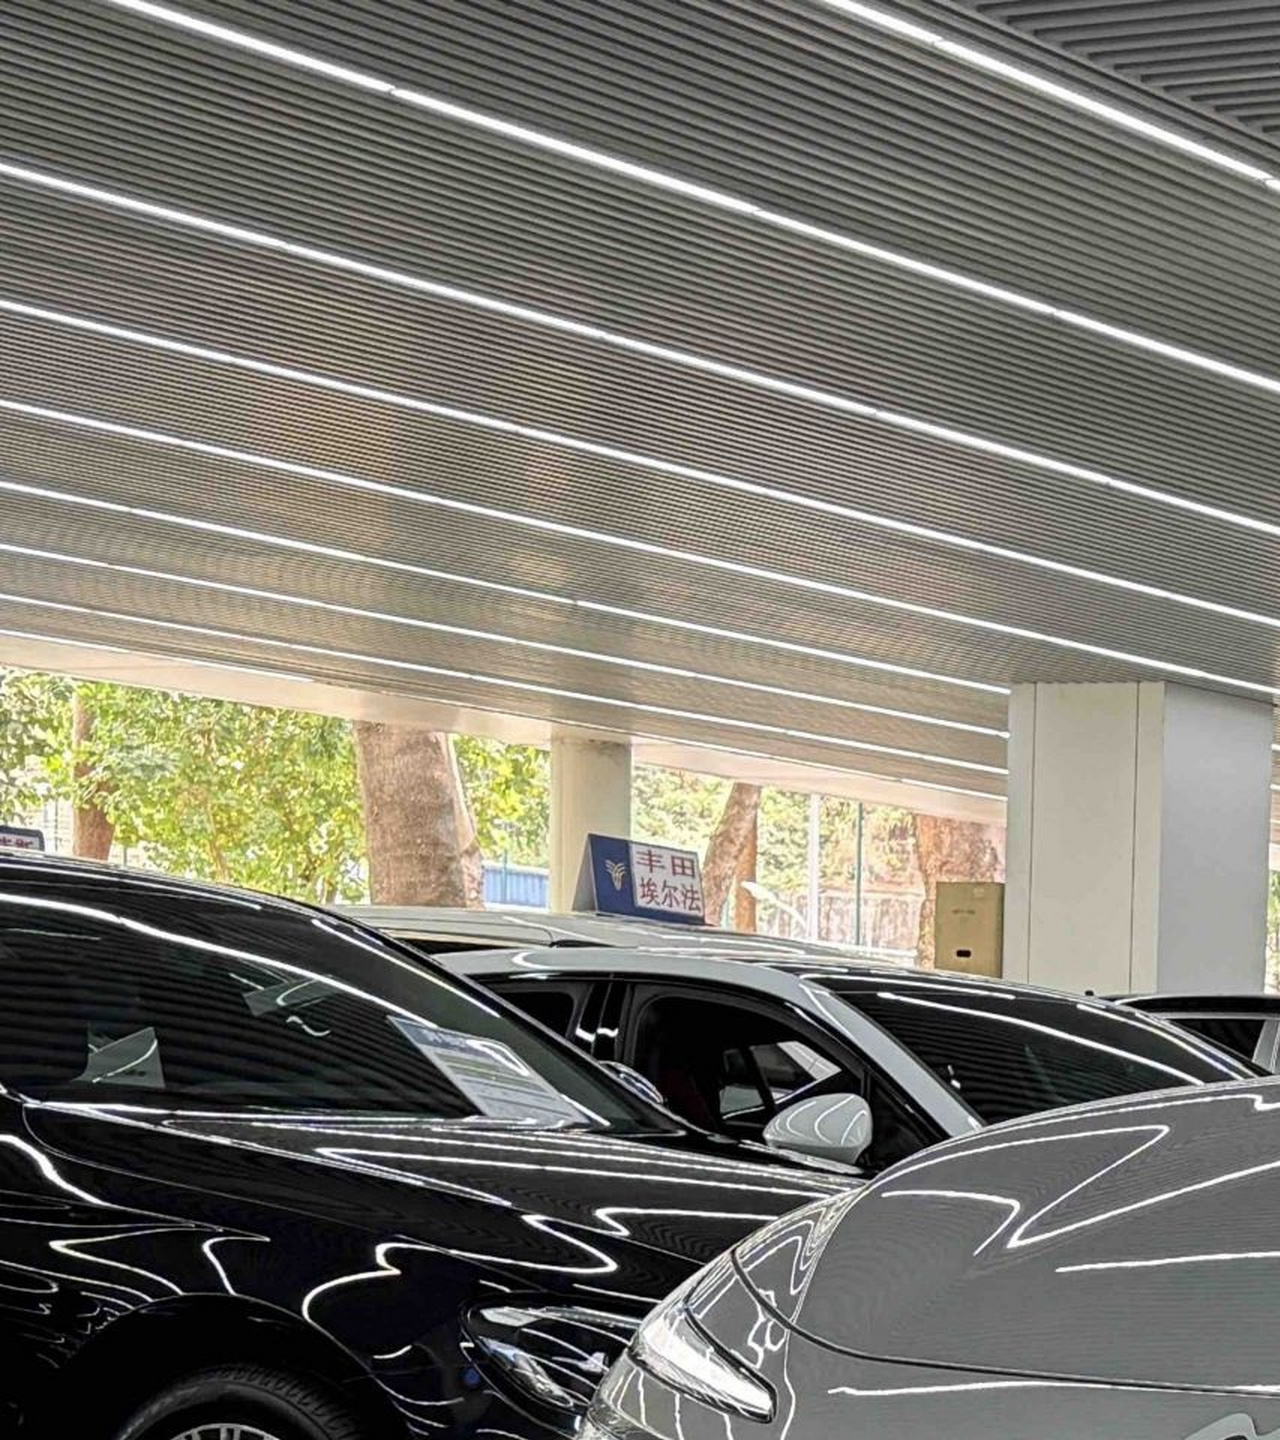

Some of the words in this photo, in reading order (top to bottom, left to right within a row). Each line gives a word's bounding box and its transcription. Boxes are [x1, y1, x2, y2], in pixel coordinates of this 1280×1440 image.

[636, 849, 696, 878] 丰田
[640, 876, 701, 911] 埃尔法
